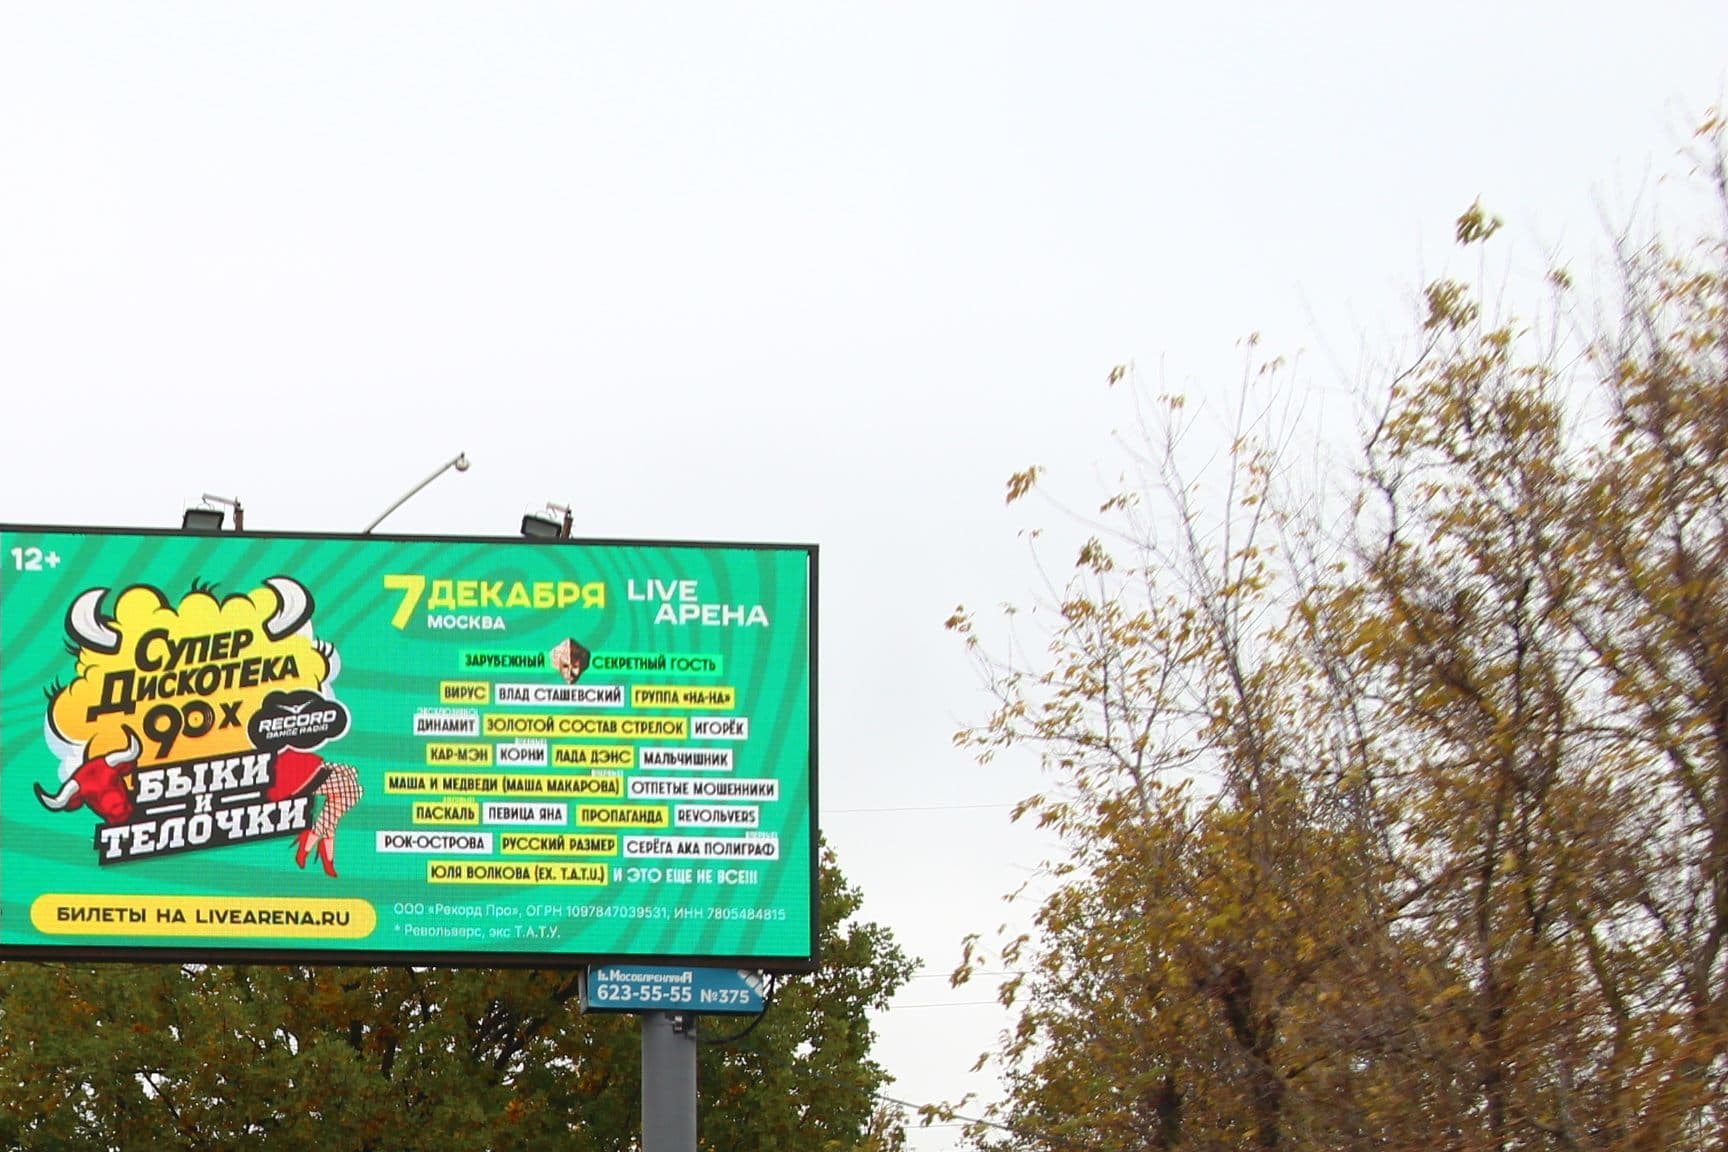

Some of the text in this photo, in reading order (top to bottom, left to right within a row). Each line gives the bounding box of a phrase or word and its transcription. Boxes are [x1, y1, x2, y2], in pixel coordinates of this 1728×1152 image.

[10, 547, 61, 571] 12+
[627, 578, 699, 602] LIVE
[383, 574, 606, 631] 7 ДЕКАБРЯ
[427, 614, 506, 631] МОСКВА
[654, 602, 770, 628] АРЕНА
[465, 652, 716, 672] ЗАРУБЕЖНЫЙ СЕКРЕТНЫЙ ГОСТЬ
[444, 686, 486, 699] ВИРУС
[499, 687, 621, 702] ВЛАД СТАШЕВСКИЙ
[635, 690, 731, 705] ГРУППА «НА-НА»
[259, 710, 337, 733] RECORD
[417, 719, 476, 732] ДИНАМИТ
[487, 716, 683, 735] ЗОЛОТОЙ СОСТАВ СТРЕЛОК
[695, 718, 745, 735] ИГОРЁК
[266, 724, 329, 739] DANCE RADIO
[431, 748, 488, 761] КАР-МЭН
[500, 748, 544, 761] КОРНИ
[555, 750, 631, 764] ЛАДА ДЭНС
[644, 752, 728, 766] МАЛЬЧИШНИК
[136, 752, 272, 803] БЫКИ
[389, 776, 619, 795] МАША И МЕДВЕДИ (МАША МАКАРОВА)
[631, 781, 774, 796] ОТПЕТЫЕ МОШЕННИКИ
[193, 794, 212, 813] И
[416, 806, 475, 820] ПАСКАЛЬ
[489, 807, 562, 821] ПЕВИЦА ЯНА
[581, 809, 663, 823] ПРОПАГАНДА
[100, 797, 309, 859] ТЕЛОЧКИ
[384, 835, 484, 850] РОК-ОСТРОВА
[502, 835, 615, 851] РУССКИЙ РАЗМЕР
[626, 838, 673, 854] СЕРЁГА
[704, 841, 775, 856] ПОЛИГРАФ
[431, 865, 462, 879] ЮЛЯ
[466, 865, 531, 880] ВОЛКОВА
[613, 867, 758, 885] И ЭТО ЕЩЕ НЕ ВСЕ!!!
[57, 907, 350, 926] БИЛЕТЫ НА LIVEARENA.RU
[394, 902, 424, 915] ООО
[526, 905, 562, 917] ОГРН
[674, 907, 703, 919] ИНН
[597, 984, 750, 1004] 623-55-55 №375
